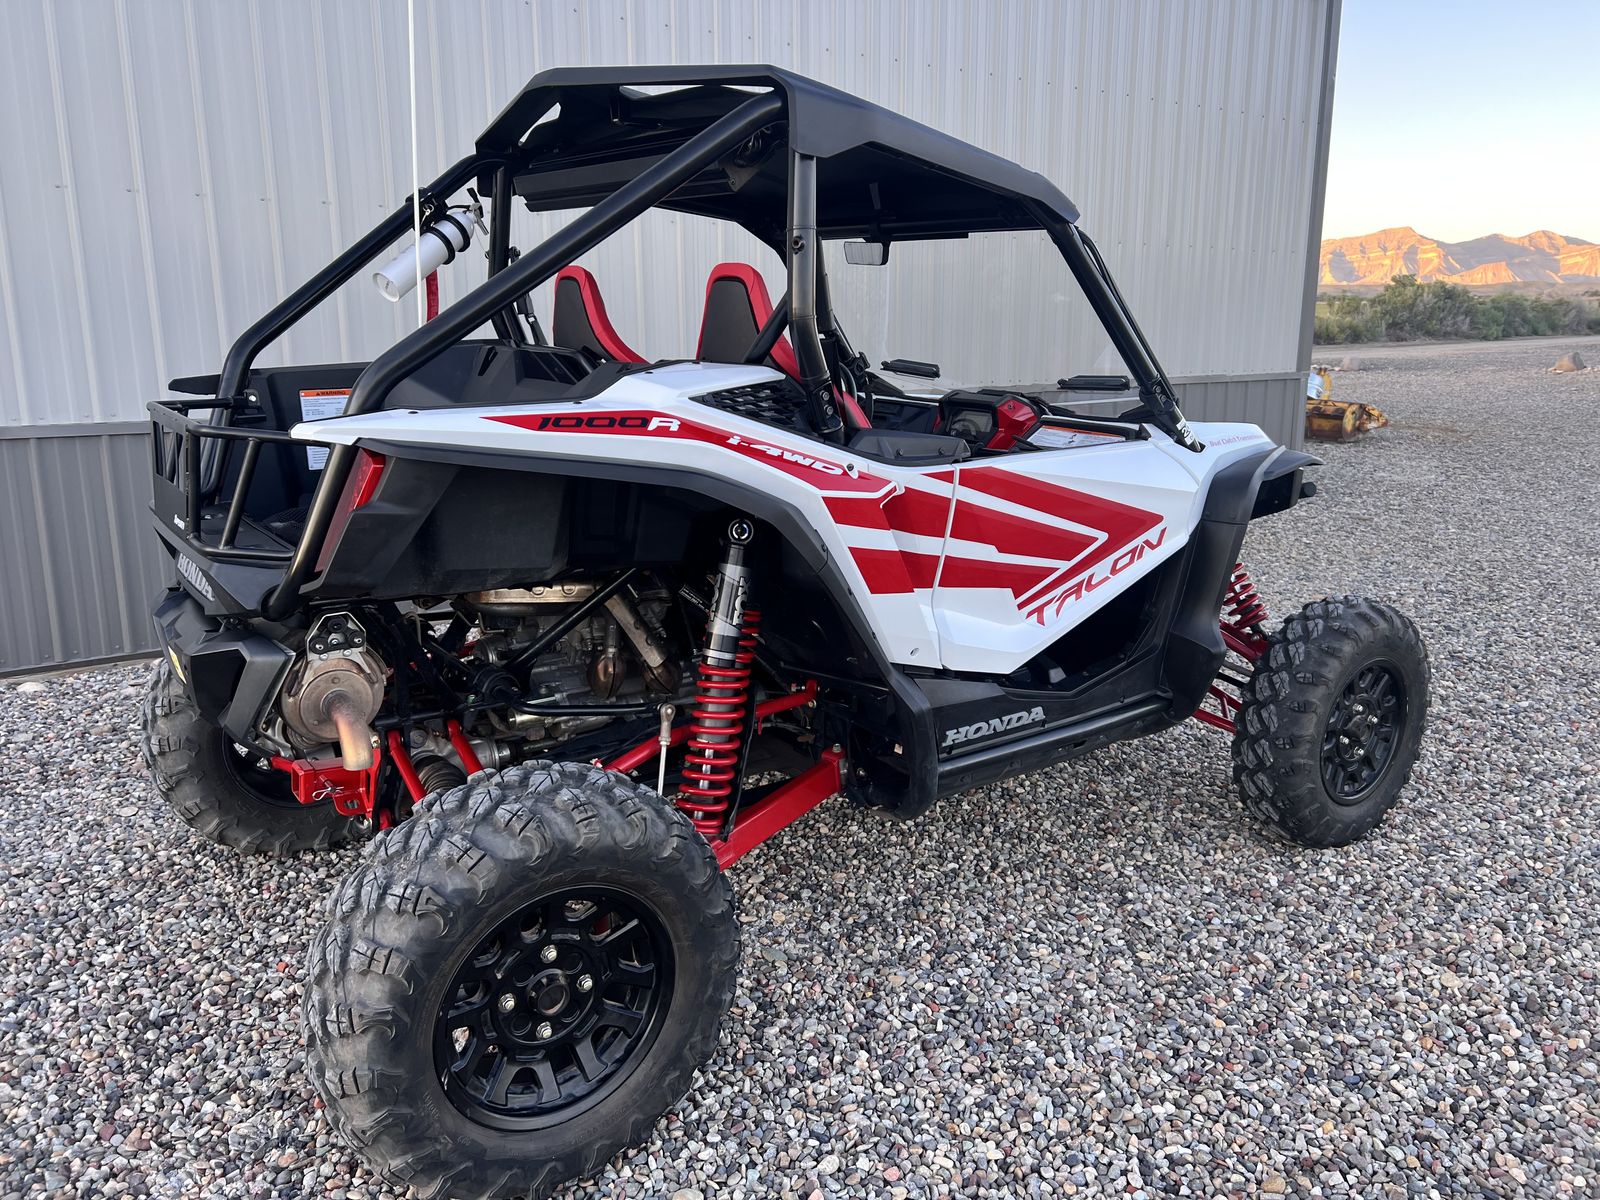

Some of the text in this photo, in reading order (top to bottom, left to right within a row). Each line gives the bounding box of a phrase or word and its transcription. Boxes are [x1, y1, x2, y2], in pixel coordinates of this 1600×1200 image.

[538, 416, 681, 431] 1000R
[726, 435, 843, 475] i-4WD
[177, 552, 215, 601] HONDA
[1025, 526, 1168, 626] TALON
[942, 706, 1046, 747] HONDA
